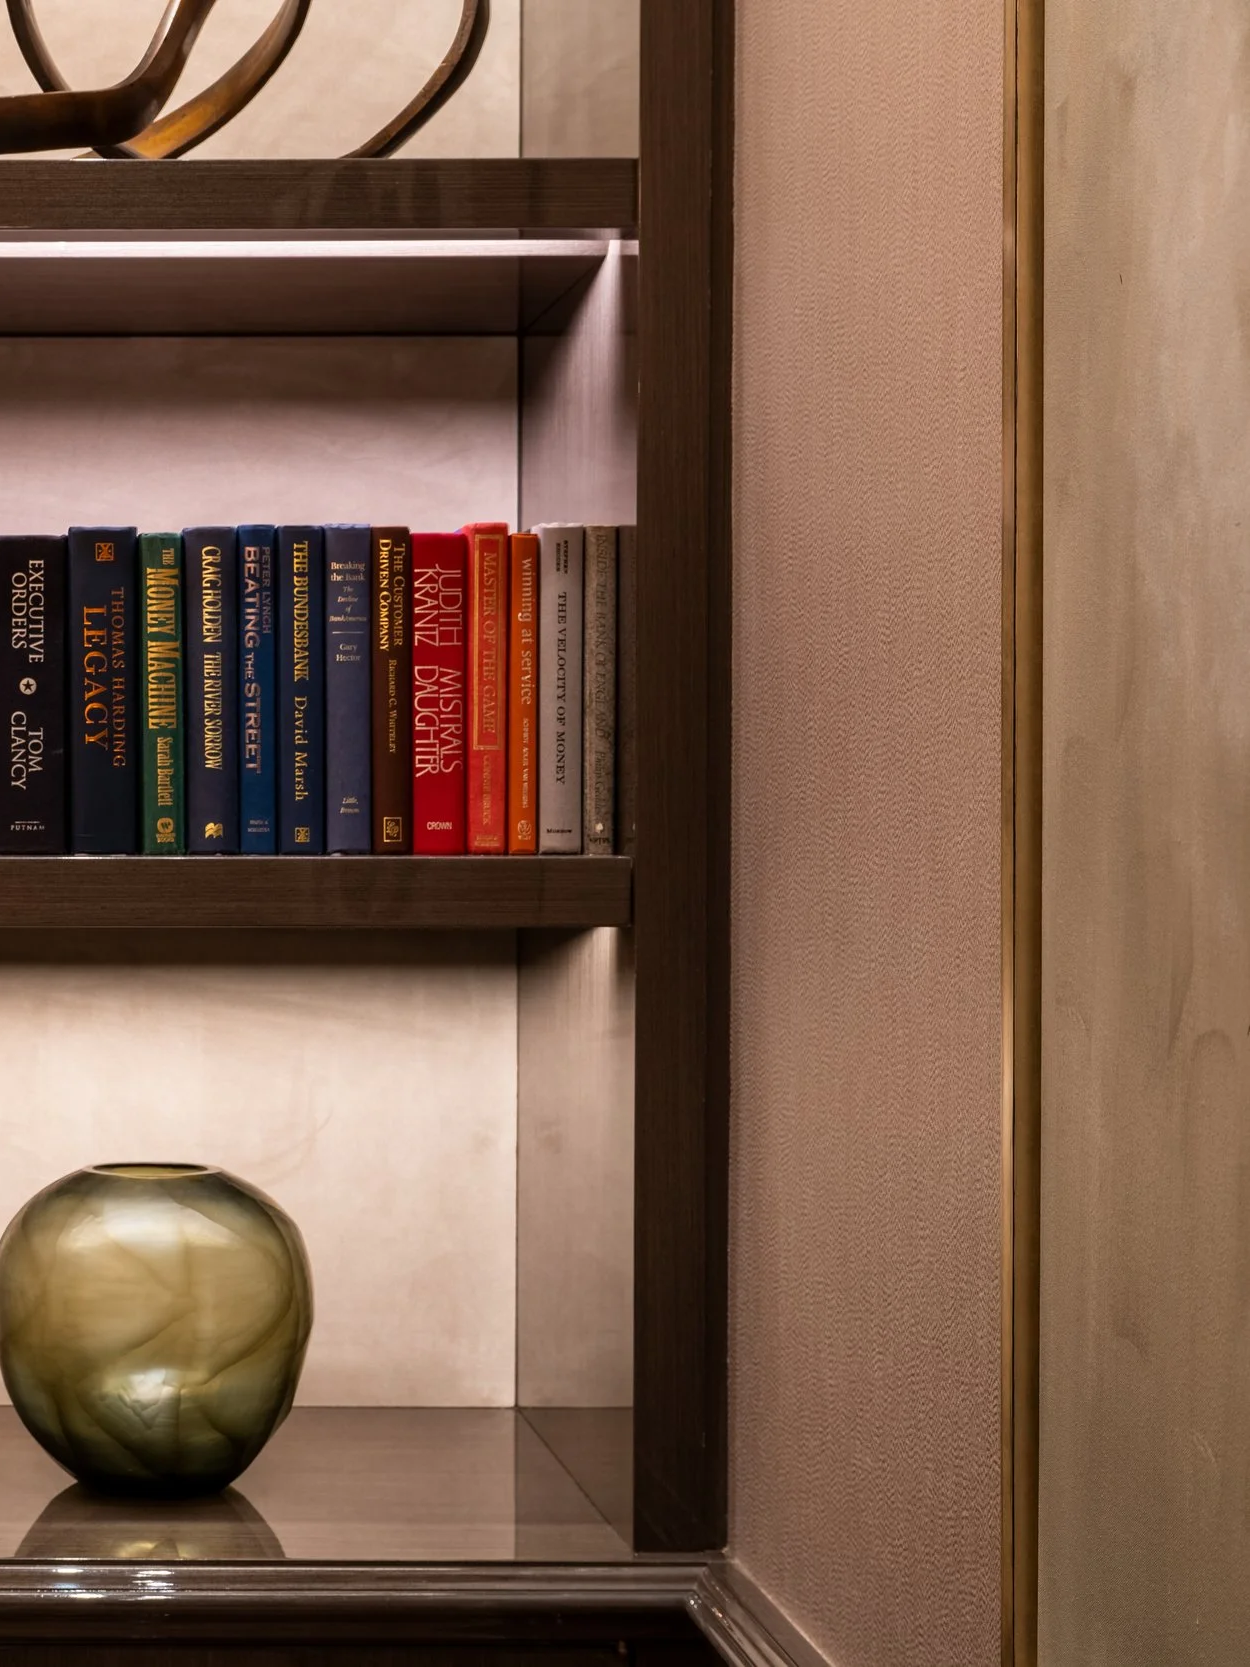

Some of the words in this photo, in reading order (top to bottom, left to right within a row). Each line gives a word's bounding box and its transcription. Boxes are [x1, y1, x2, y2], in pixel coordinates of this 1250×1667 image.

[162, 548, 174, 565] THE
[202, 546, 221, 587] CRAIG
[262, 547, 270, 587] PETER
[293, 541, 308, 573] THE
[331, 562, 365, 571] Breaking
[331, 572, 344, 581] the
[346, 572, 365, 581] Bank
[379, 539, 391, 588] DRIVEN
[393, 544, 405, 572] THE
[595, 534, 608, 579] INSIDE
[146, 567, 179, 636] MONEY
[244, 546, 259, 648] BEATING
[436, 564, 462, 646] JUDITH
[483, 552, 496, 615] MASTER
[517, 558, 535, 622] winning
[596, 581, 608, 610] THE
[11, 572, 27, 649] ORDERS
[28, 559, 44, 663] EXECUTIVE
[111, 587, 125, 669] THOMAS
[202, 590, 221, 643] HOLDEN
[262, 591, 271, 634] LYNCH
[293, 576, 309, 682] BUNDESBANK
[346, 605, 352, 613] of
[379, 591, 391, 651] COMPANY
[393, 576, 405, 646] CUSTOMER
[414, 568, 438, 647] KRANTZ
[557, 592, 567, 625] THE
[596, 612, 608, 648] BANK
[340, 643, 357, 651] Gary
[483, 621, 496, 642] OF
[521, 629, 534, 644] at
[83, 606, 107, 751] LEGACY
[146, 641, 180, 729] MACHINE
[203, 653, 221, 677] THE
[244, 652, 255, 679] THE
[388, 660, 397, 696] RICHARD
[483, 648, 495, 680] THE
[521, 650, 535, 705] service
[556, 628, 567, 701] VELOCITY
[204, 679, 222, 716] RIVER
[439, 668, 463, 773] MISTRAL'S
[483, 687, 496, 733] GAME
[556, 706, 566, 727] OF
[595, 668, 609, 741] ENGLAND
[112, 677, 125, 767] HARDING
[245, 682, 261, 774] STREET
[294, 697, 308, 745] David
[415, 665, 439, 778] DAUGHTER
[10, 711, 26, 790] CLANCY
[28, 728, 43, 772] TOM
[157, 737, 173, 766] Sarah
[205, 719, 223, 770] SORROW
[556, 731, 567, 785] MONEY
[157, 769, 174, 806] Bartlett
[295, 752, 308, 801] Marsh
[482, 755, 491, 791] CONNIE
[426, 821, 452, 830] CROWN
[482, 793, 491, 825] BRUCK
